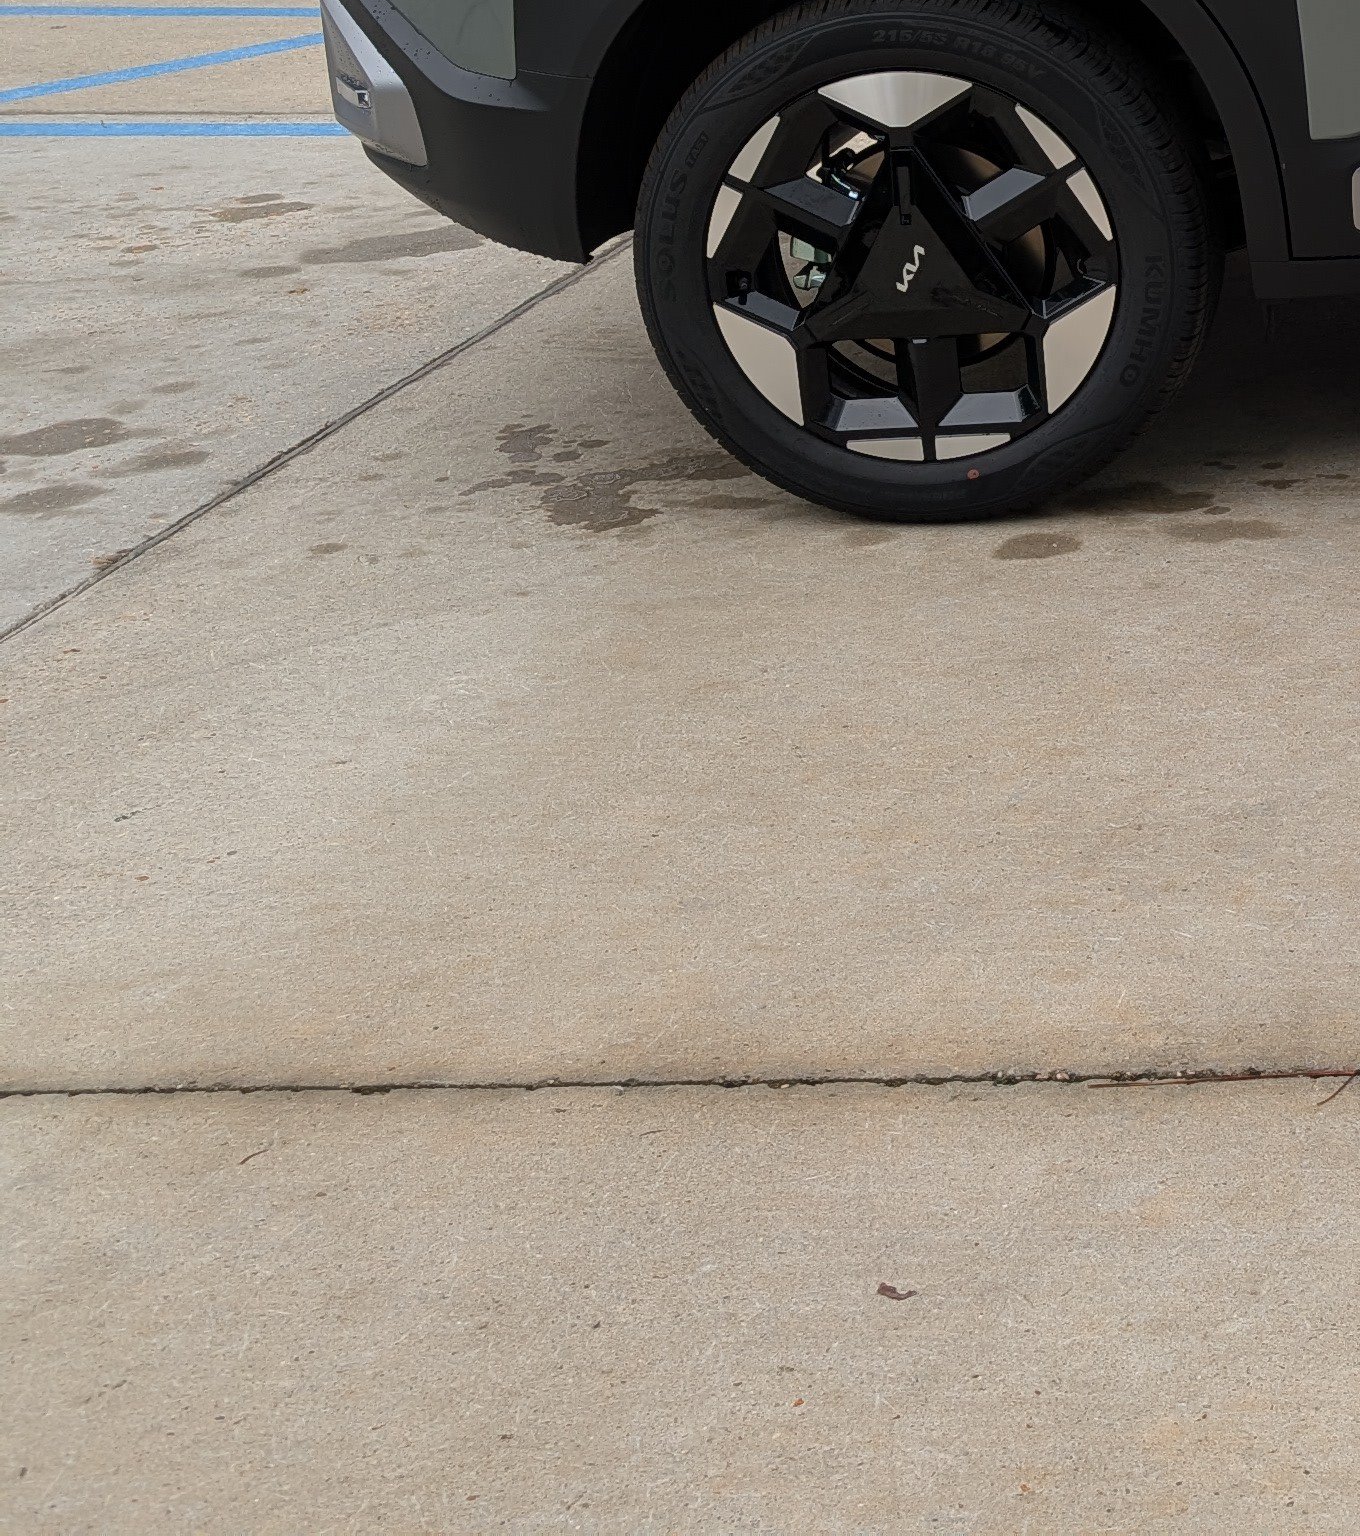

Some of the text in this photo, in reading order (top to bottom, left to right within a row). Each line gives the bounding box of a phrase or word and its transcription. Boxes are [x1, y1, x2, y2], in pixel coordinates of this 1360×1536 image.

[656, 169, 690, 302] SOLUS
[895, 244, 926, 293] KIA
[1119, 255, 1164, 388] KUMHO
